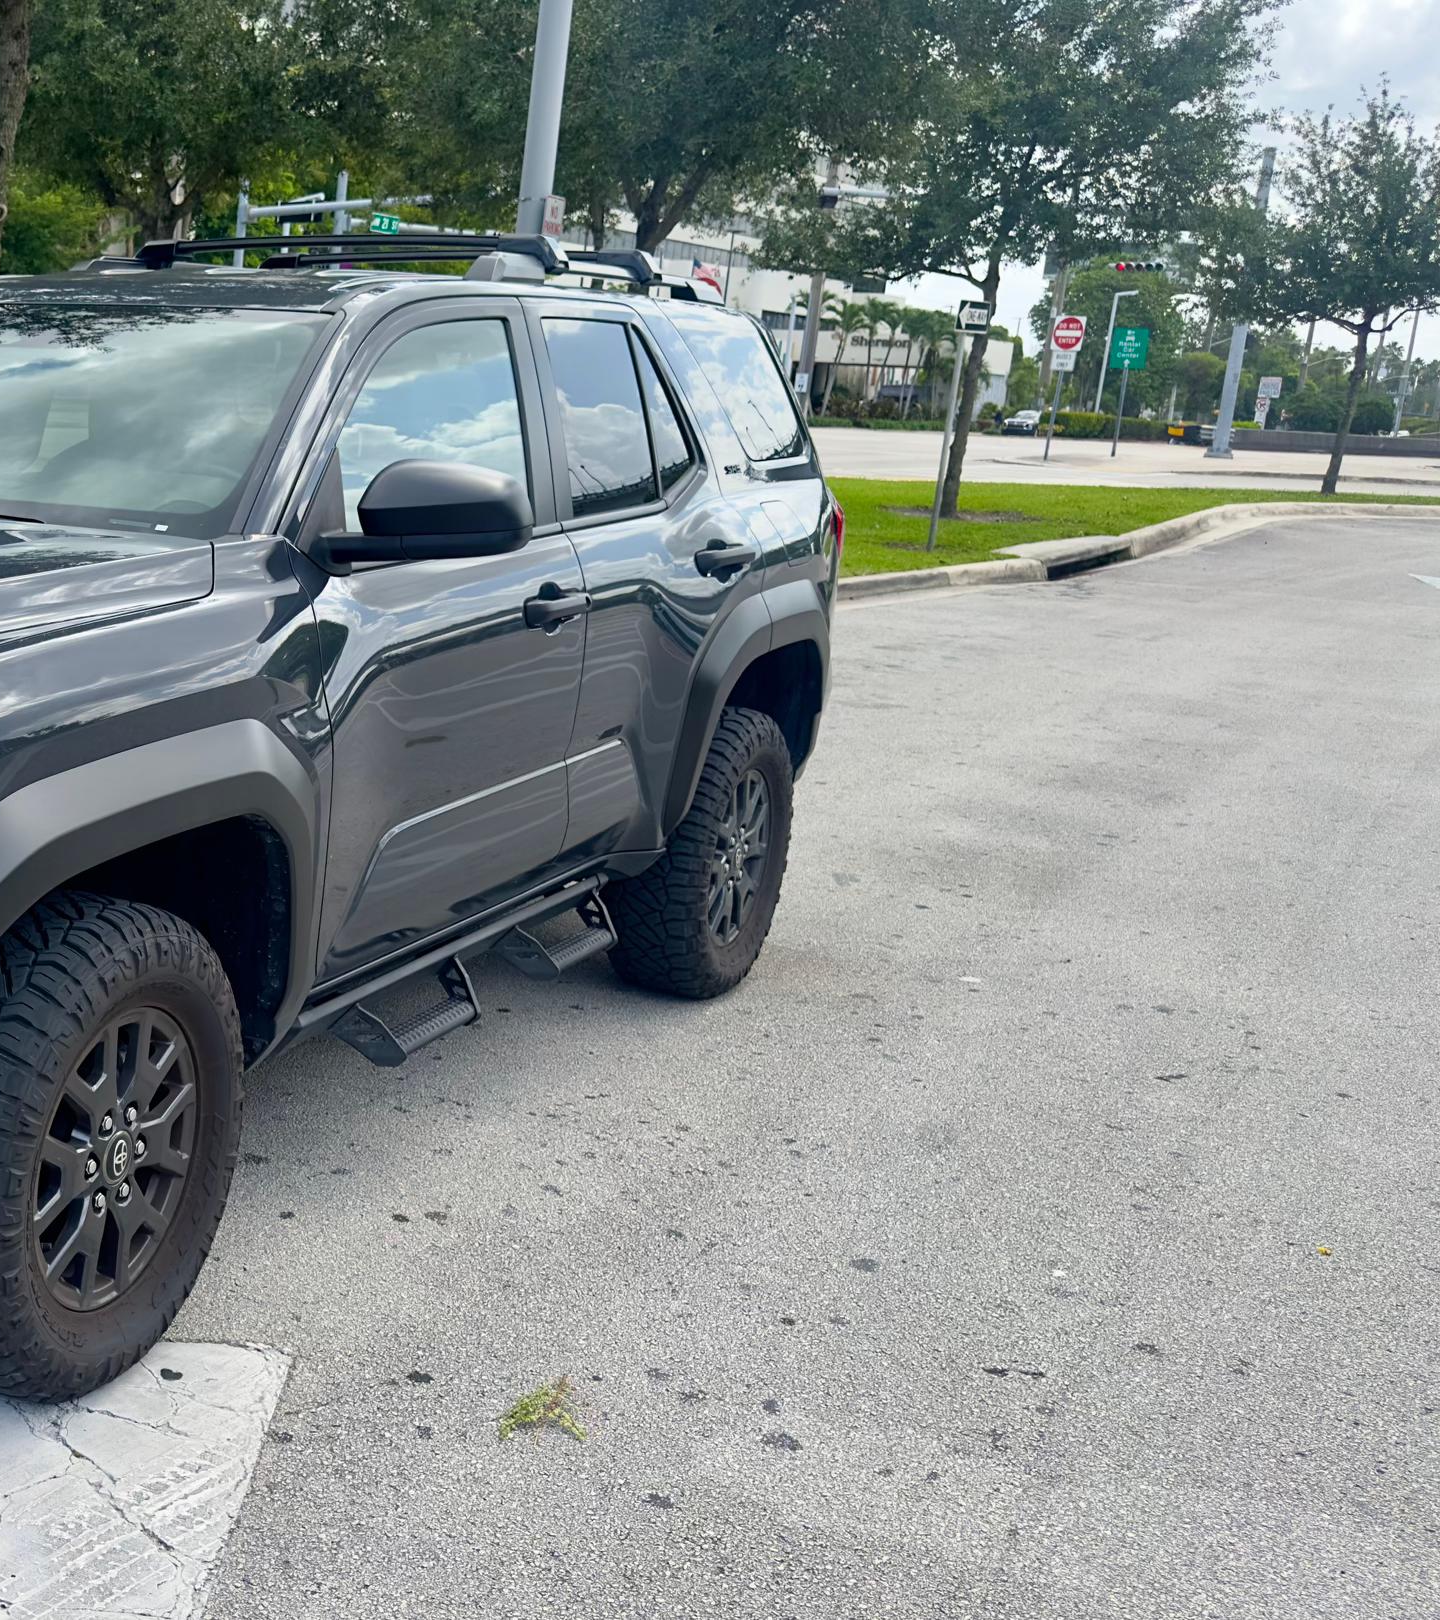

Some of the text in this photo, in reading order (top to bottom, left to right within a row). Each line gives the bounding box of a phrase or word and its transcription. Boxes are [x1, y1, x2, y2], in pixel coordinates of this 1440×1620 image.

[551, 206, 559, 219] NO
[381, 217, 389, 229] 21
[1069, 322, 1081, 330] NOT
[850, 335, 911, 348] Sheraon
